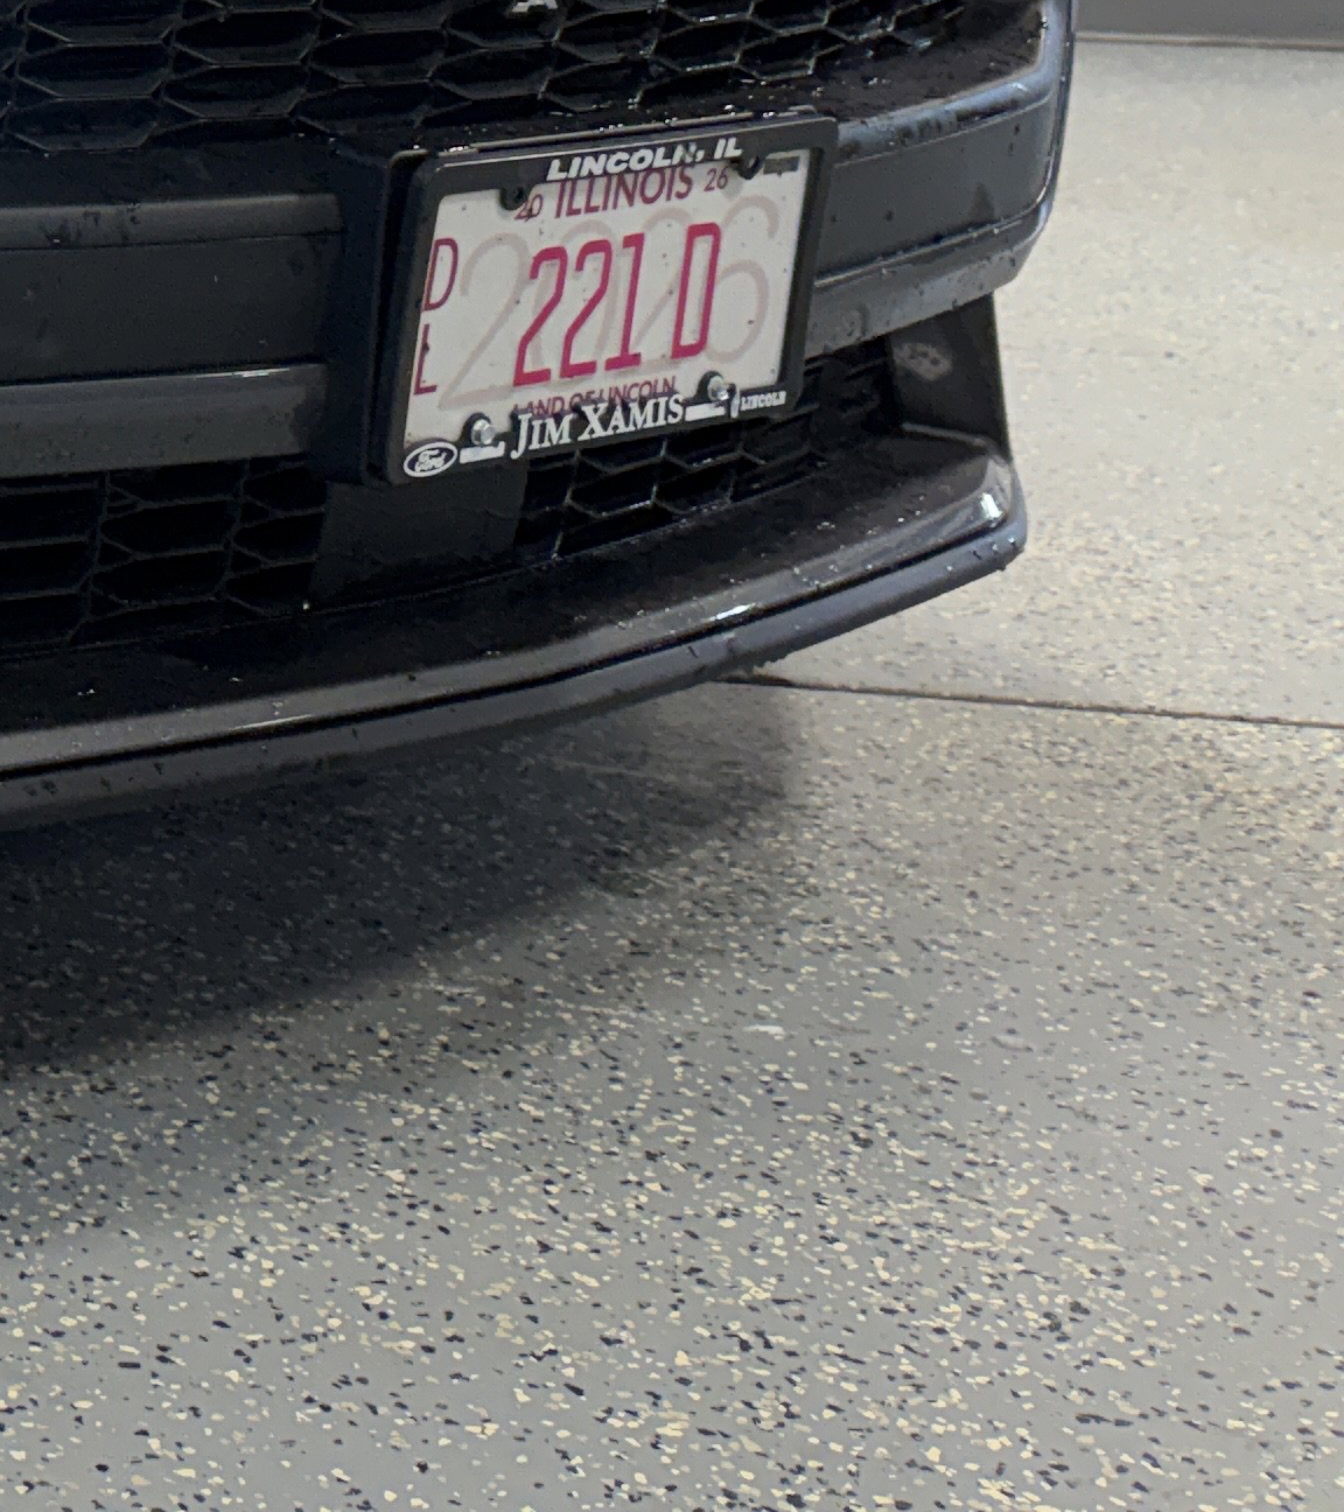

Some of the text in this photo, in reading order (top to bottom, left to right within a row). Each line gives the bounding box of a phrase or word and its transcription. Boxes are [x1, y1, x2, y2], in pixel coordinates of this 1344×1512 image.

[546, 137, 744, 182] LINCOLN, IL
[554, 165, 694, 219] ILLINOIS
[703, 167, 729, 192] 26
[510, 393, 685, 460] JIM XAMIS
